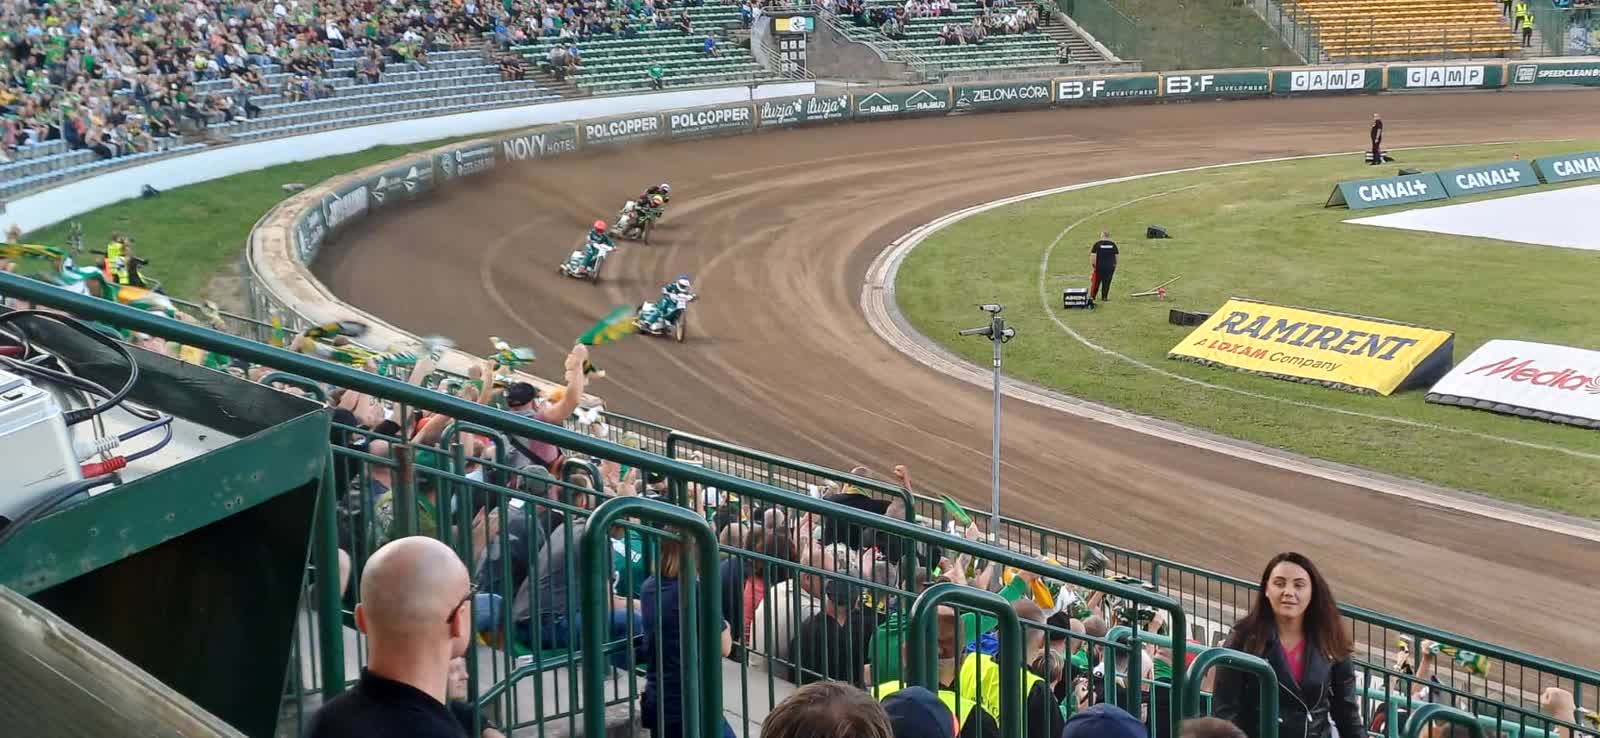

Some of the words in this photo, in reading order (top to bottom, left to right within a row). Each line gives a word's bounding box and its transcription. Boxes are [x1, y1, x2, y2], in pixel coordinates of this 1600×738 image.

[1295, 72, 1360, 87] GAMP
[1411, 69, 1480, 83] GAMP
[973, 88, 1019, 103] ZIELONA
[1019, 85, 1049, 99] GÓRA
[1215, 84, 1268, 93] DEVELOPMENT
[586, 116, 658, 139] POLCOPPER
[671, 107, 749, 129] POLCOPPER
[503, 134, 546, 162] NOVY
[546, 138, 577, 155] HOTEL
[1455, 167, 1521, 190] CANAL+
[1358, 179, 1428, 202] CANAL+
[1212, 310, 1419, 361] RAMIRENT
[1193, 338, 1206, 347] A
[1207, 340, 1269, 360] LOXAM
[1268, 352, 1343, 372] Company
[1464, 356, 1593, 391] Media
